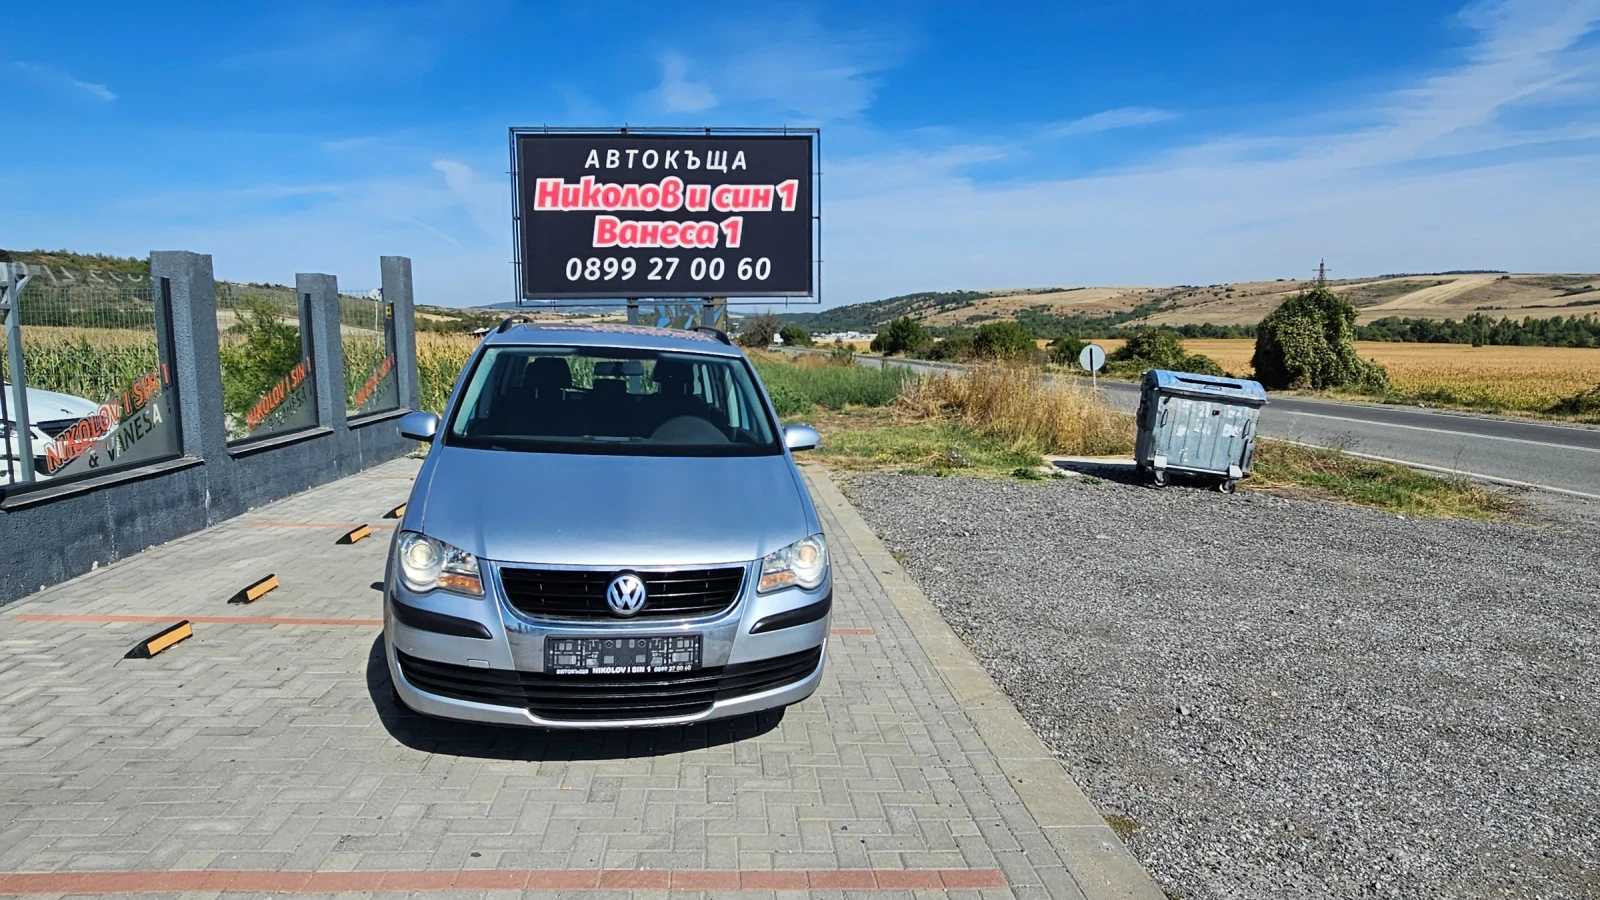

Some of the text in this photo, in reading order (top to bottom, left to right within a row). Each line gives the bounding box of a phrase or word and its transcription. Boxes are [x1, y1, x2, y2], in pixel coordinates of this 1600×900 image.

[584, 149, 748, 174] АВТОКЪЩА
[534, 175, 799, 212] Николов и син 1
[592, 215, 743, 249] Ванеса 1
[565, 257, 772, 281] 0899 27 00 60
[45, 396, 120, 472] NIKOLOV
[121, 390, 132, 416] I
[104, 402, 163, 462] VANESA
[592, 666, 627, 674] NIKOLOV
[631, 665, 645, 673] SIN
[646, 665, 651, 673] 1
